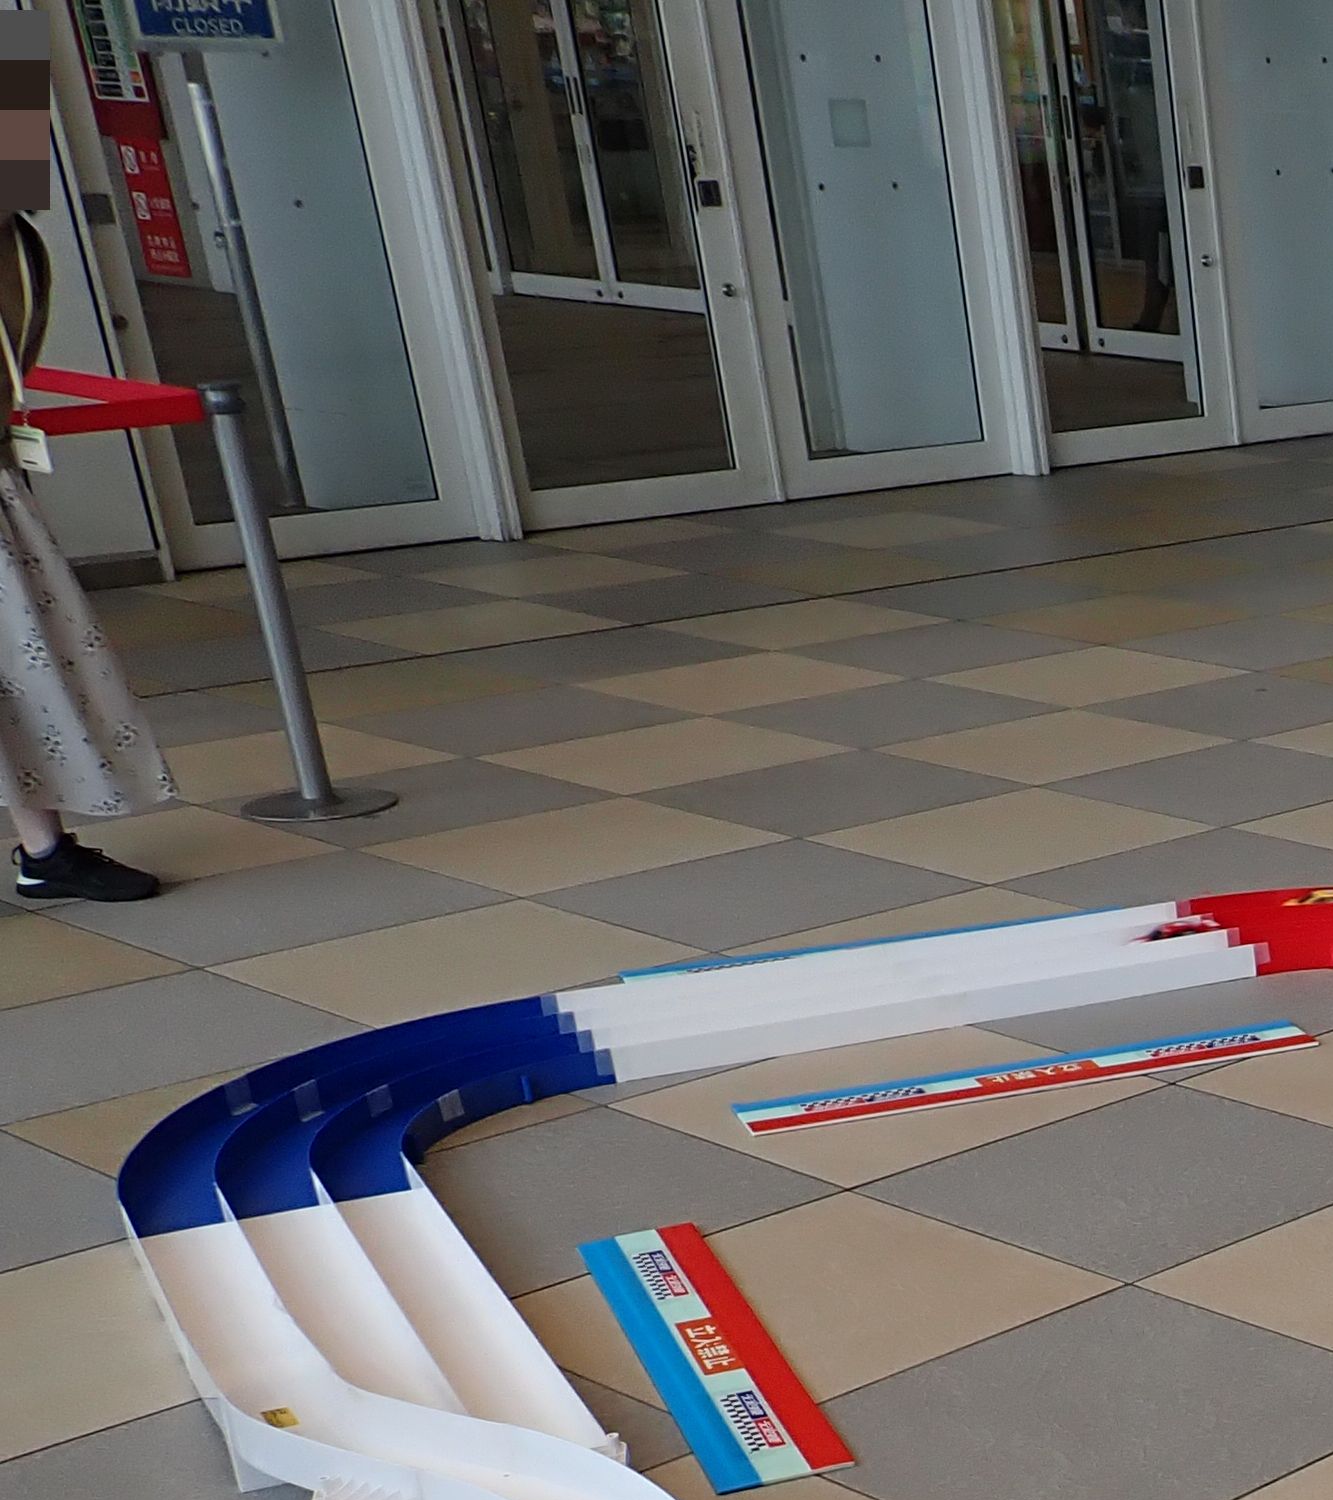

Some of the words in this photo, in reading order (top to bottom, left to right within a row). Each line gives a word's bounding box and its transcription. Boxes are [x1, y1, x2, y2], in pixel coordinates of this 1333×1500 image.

[172, 17, 243, 34] CLOSED
[685, 1324, 736, 1370] 立入禁止
